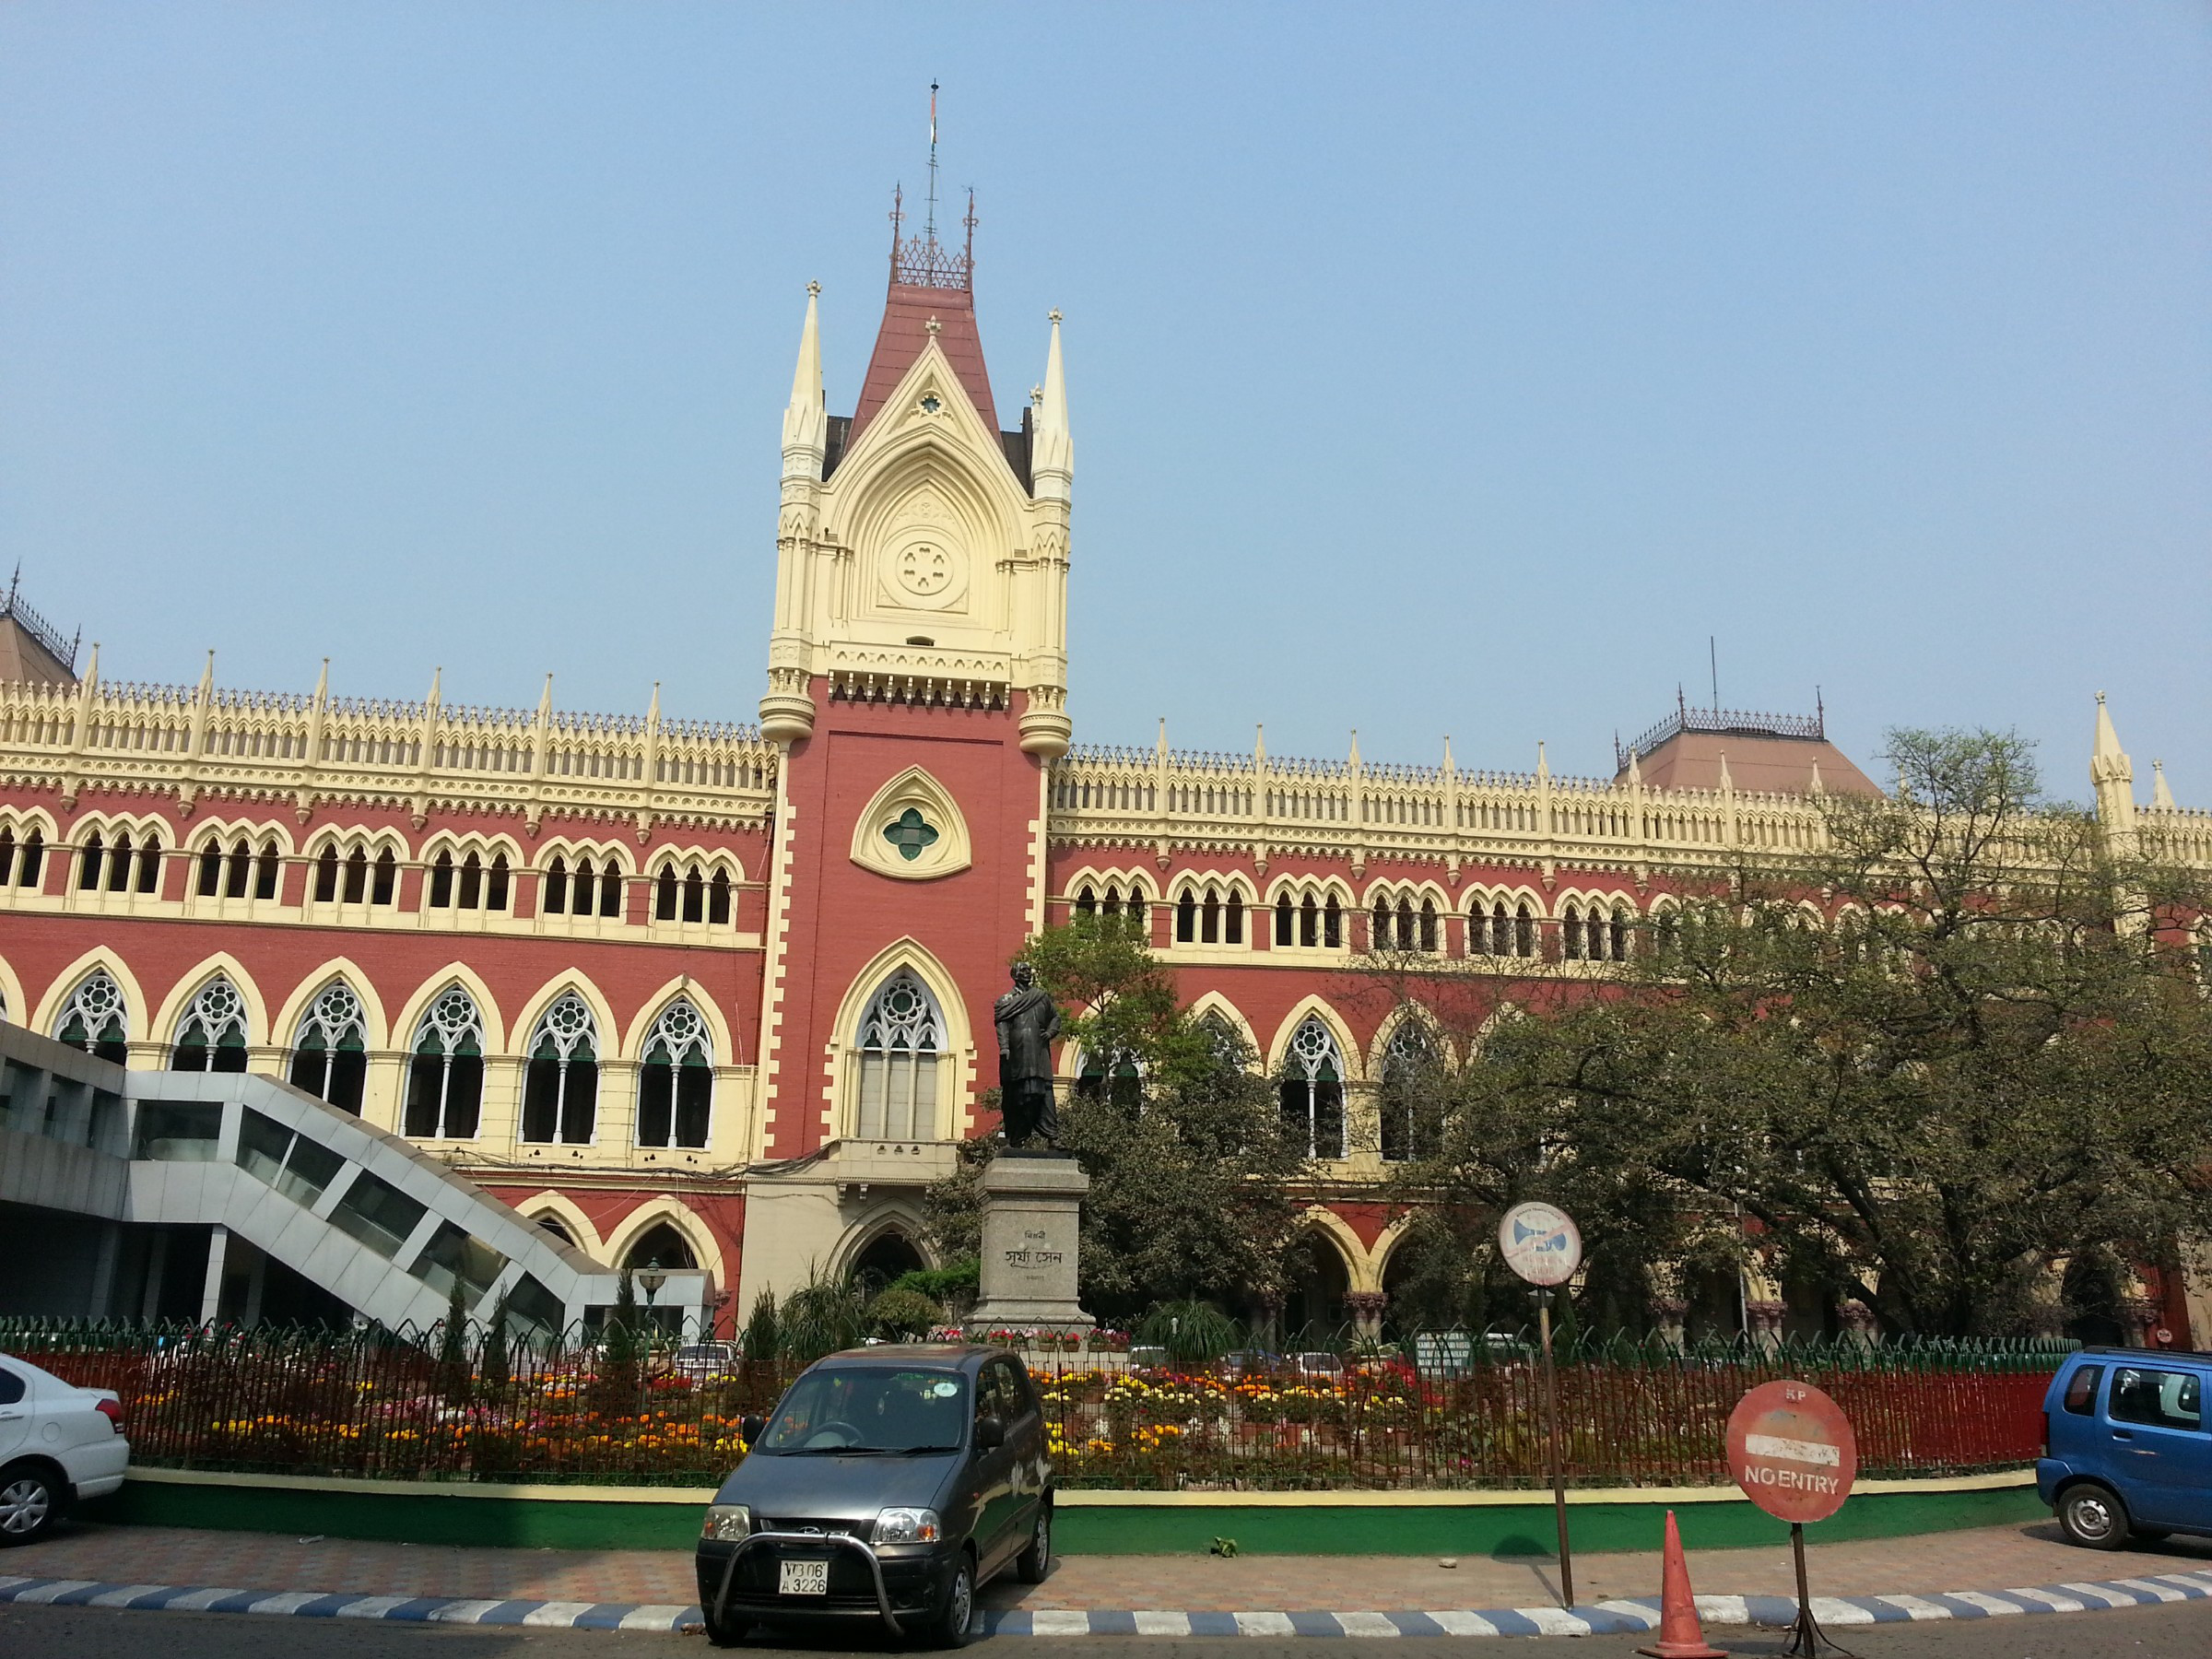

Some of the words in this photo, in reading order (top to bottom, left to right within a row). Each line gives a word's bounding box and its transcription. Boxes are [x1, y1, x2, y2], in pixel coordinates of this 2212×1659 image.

[1035, 1252, 1063, 1264] সেন
[1745, 1465, 1776, 1486] NO
[1778, 1469, 1840, 1495] ENTRY
[782, 1581, 790, 1592] A
[793, 1578, 826, 1593] 3226
